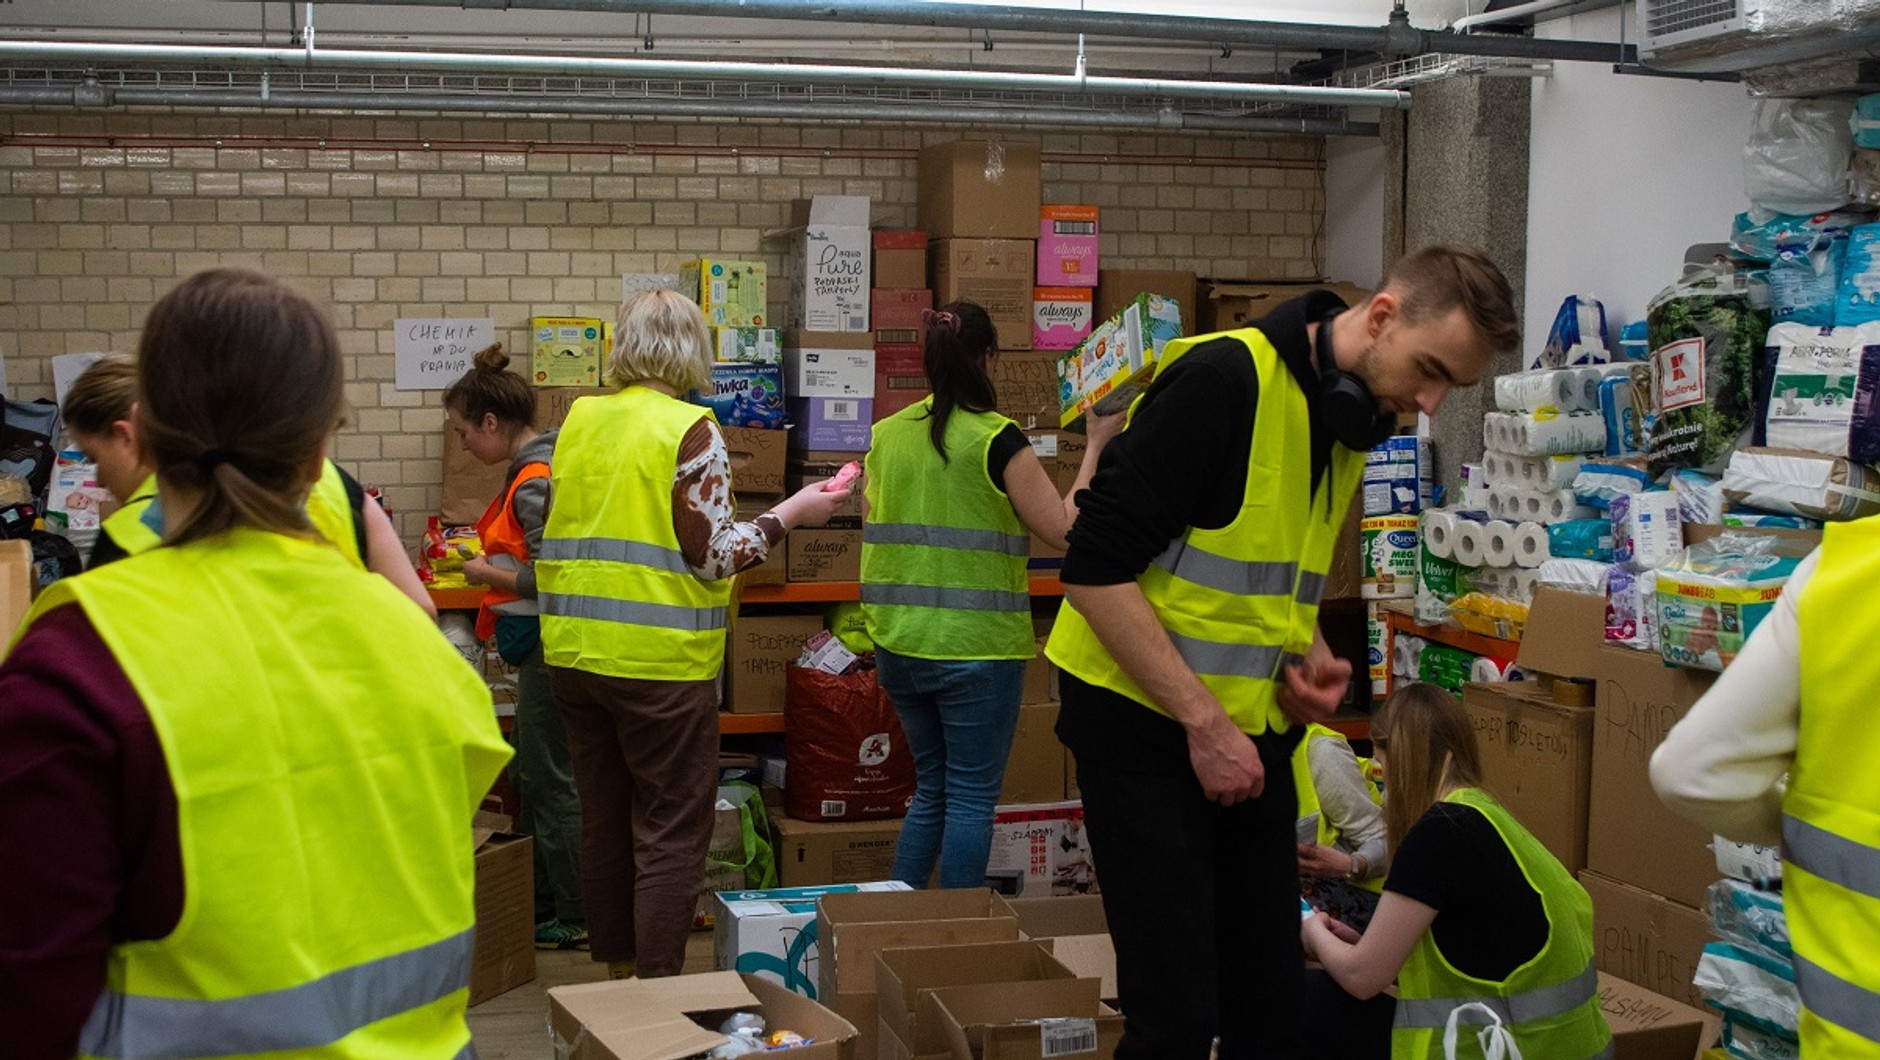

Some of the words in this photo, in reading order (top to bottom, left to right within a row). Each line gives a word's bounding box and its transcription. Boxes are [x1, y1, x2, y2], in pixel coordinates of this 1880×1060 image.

[838, 250, 862, 259] aqua
[1054, 242, 1092, 258] always
[816, 244, 863, 275] Pure
[1039, 302, 1083, 321] always
[408, 324, 478, 341] CHEMIA
[1663, 382, 1697, 398] Kaufland
[804, 539, 849, 557] always
[1760, 585, 1784, 601] JUM
